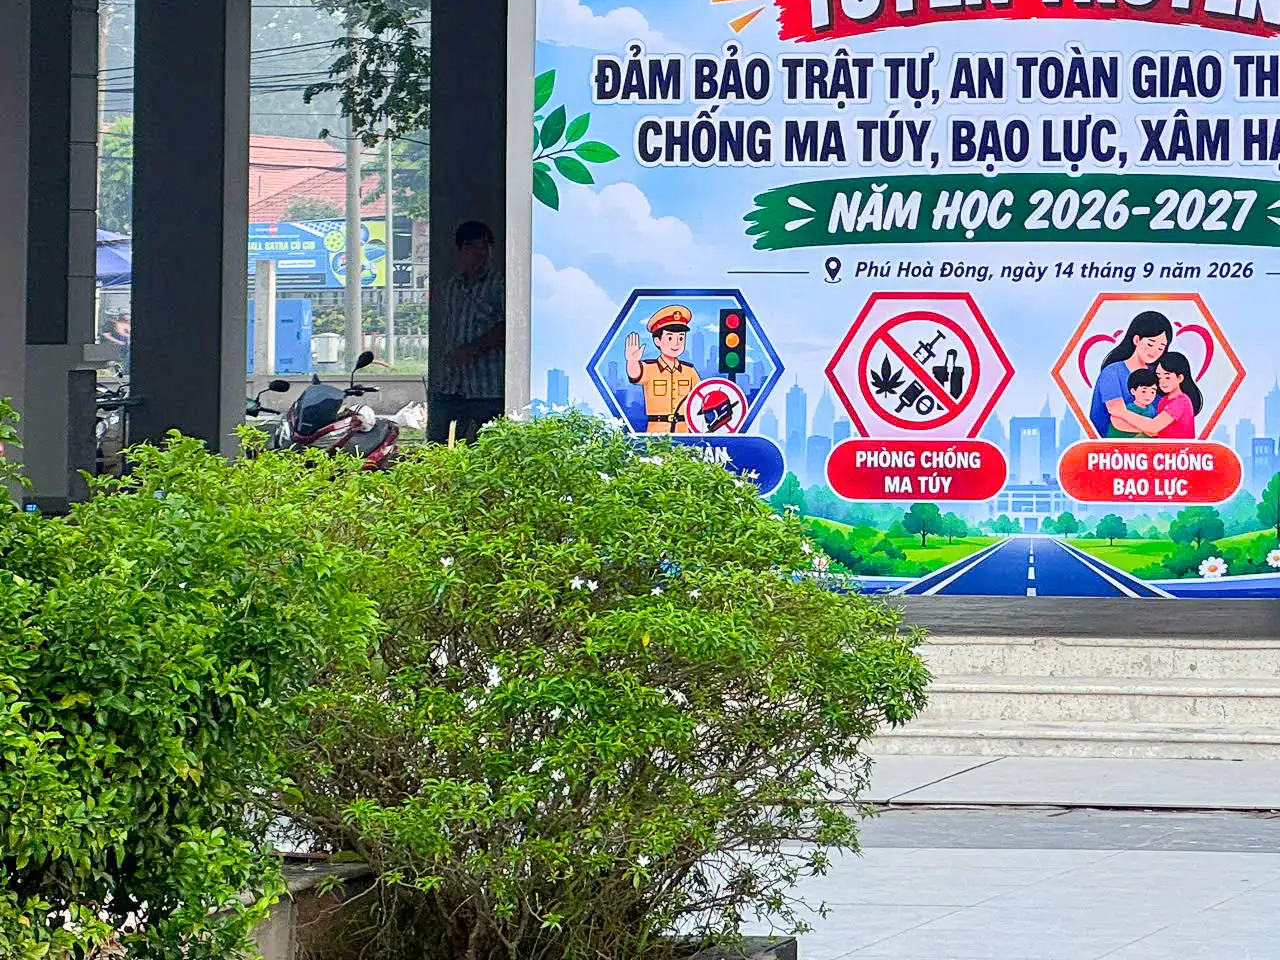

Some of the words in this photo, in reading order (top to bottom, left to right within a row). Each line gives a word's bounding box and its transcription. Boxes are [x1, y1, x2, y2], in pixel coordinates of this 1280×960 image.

[594, 44, 681, 101] ĐẢM
[693, 44, 772, 102] BẢO
[782, 48, 874, 110] TRẬT
[884, 50, 940, 109] TỰ,
[949, 57, 1004, 99] AN
[1016, 46, 1119, 99] TOÀN
[1131, 55, 1222, 98] GIAO
[637, 106, 772, 163] CHỐNG
[784, 119, 847, 162] MA
[857, 111, 940, 169] TÚY,
[951, 119, 1030, 175] BẠO
[1042, 113, 1129, 172] LỰC,
[1140, 109, 1232, 162] XÂM
[828, 183, 922, 233] NĂM
[932, 189, 1014, 239] HỌC
[1023, 188, 1258, 232] 2026-2027
[854, 260, 892, 279] Phú
[897, 260, 934, 279] Hoà
[939, 260, 994, 282] Đông,
[1000, 260, 1049, 283] ngày
[1054, 261, 1075, 279] 14
[1080, 260, 1137, 283] tháng
[1142, 261, 1155, 279] 9
[1160, 260, 1201, 279] năm
[1206, 261, 1254, 279] 2026
[855, 448, 916, 469] PHÒNG
[919, 447, 981, 470] CHỐNG
[1087, 450, 1148, 471] PHÒNG
[1153, 448, 1214, 472] CHỐNG
[884, 476, 912, 494] MA
[917, 473, 952, 495] TÚY
[1112, 477, 1149, 501] BẠO
[1154, 475, 1188, 500] LỰC
